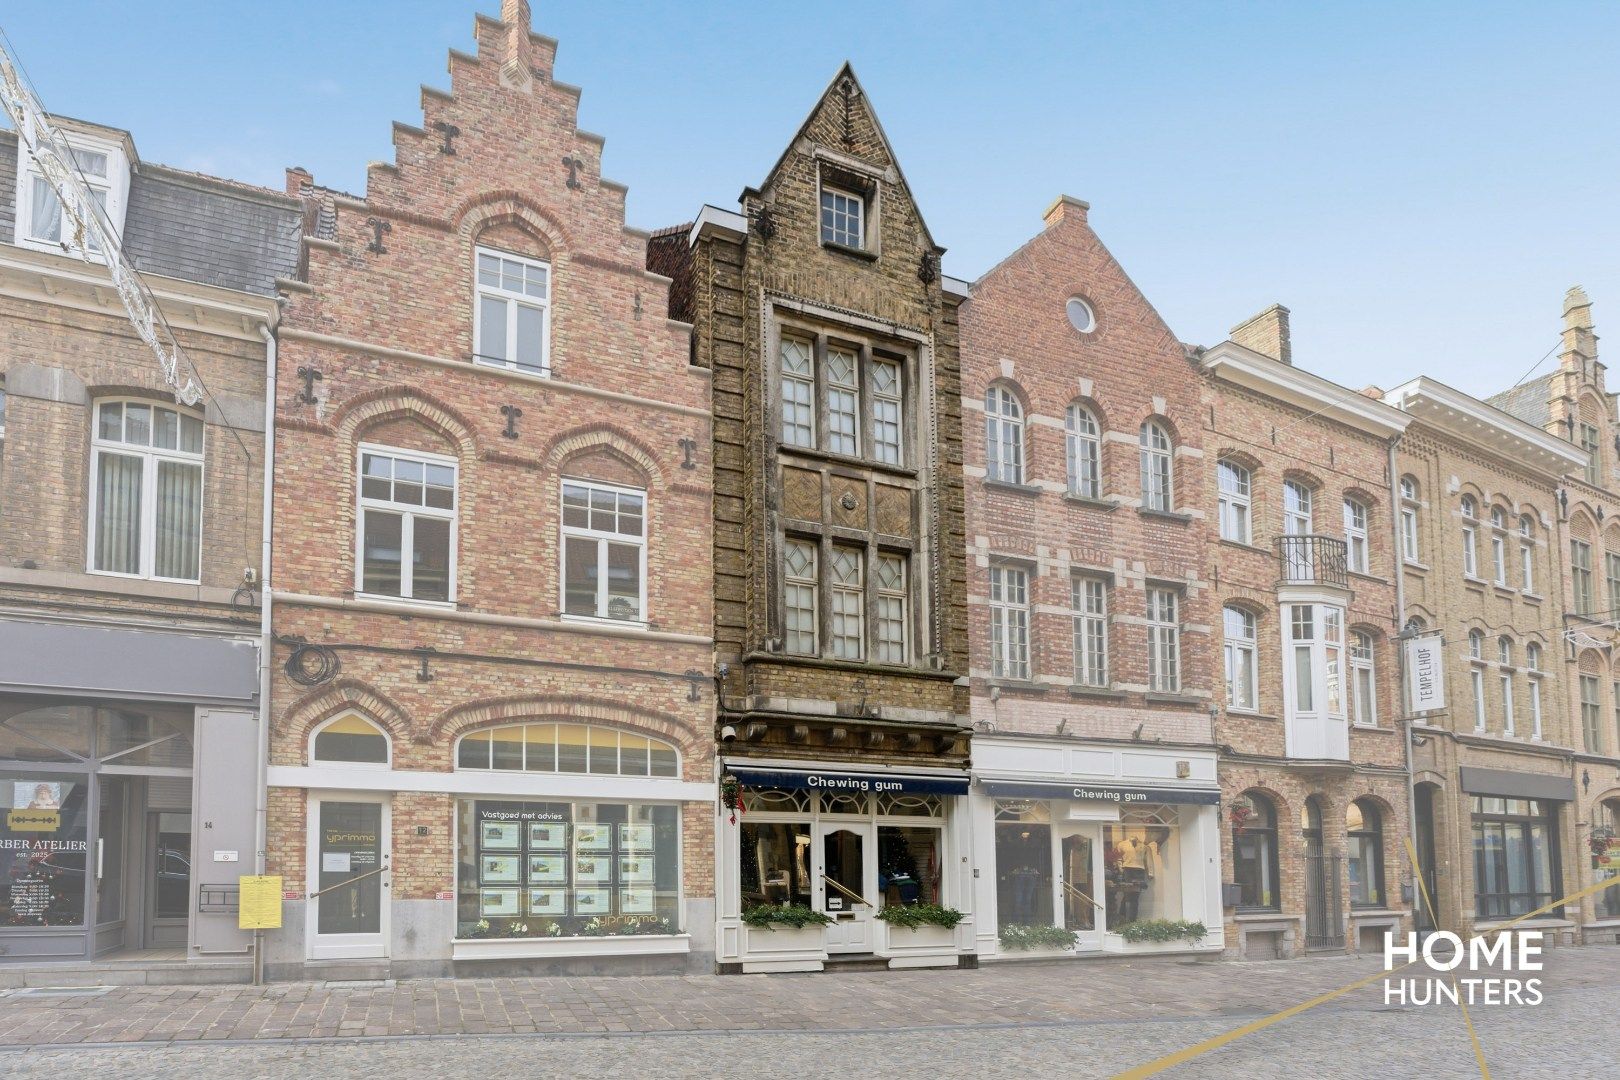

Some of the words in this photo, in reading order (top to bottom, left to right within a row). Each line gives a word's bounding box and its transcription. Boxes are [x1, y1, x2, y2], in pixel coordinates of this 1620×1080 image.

[1418, 648, 1433, 702] TEMPELHOF
[807, 775, 869, 791] Chewing
[875, 781, 903, 792] gum
[1073, 788, 1120, 802] Chewing
[1124, 793, 1147, 802] gum
[481, 810, 520, 820] Vastgoed
[537, 812, 563, 820] advies
[326, 833, 376, 843] yprimmo
[33, 840, 87, 850] ATELIER
